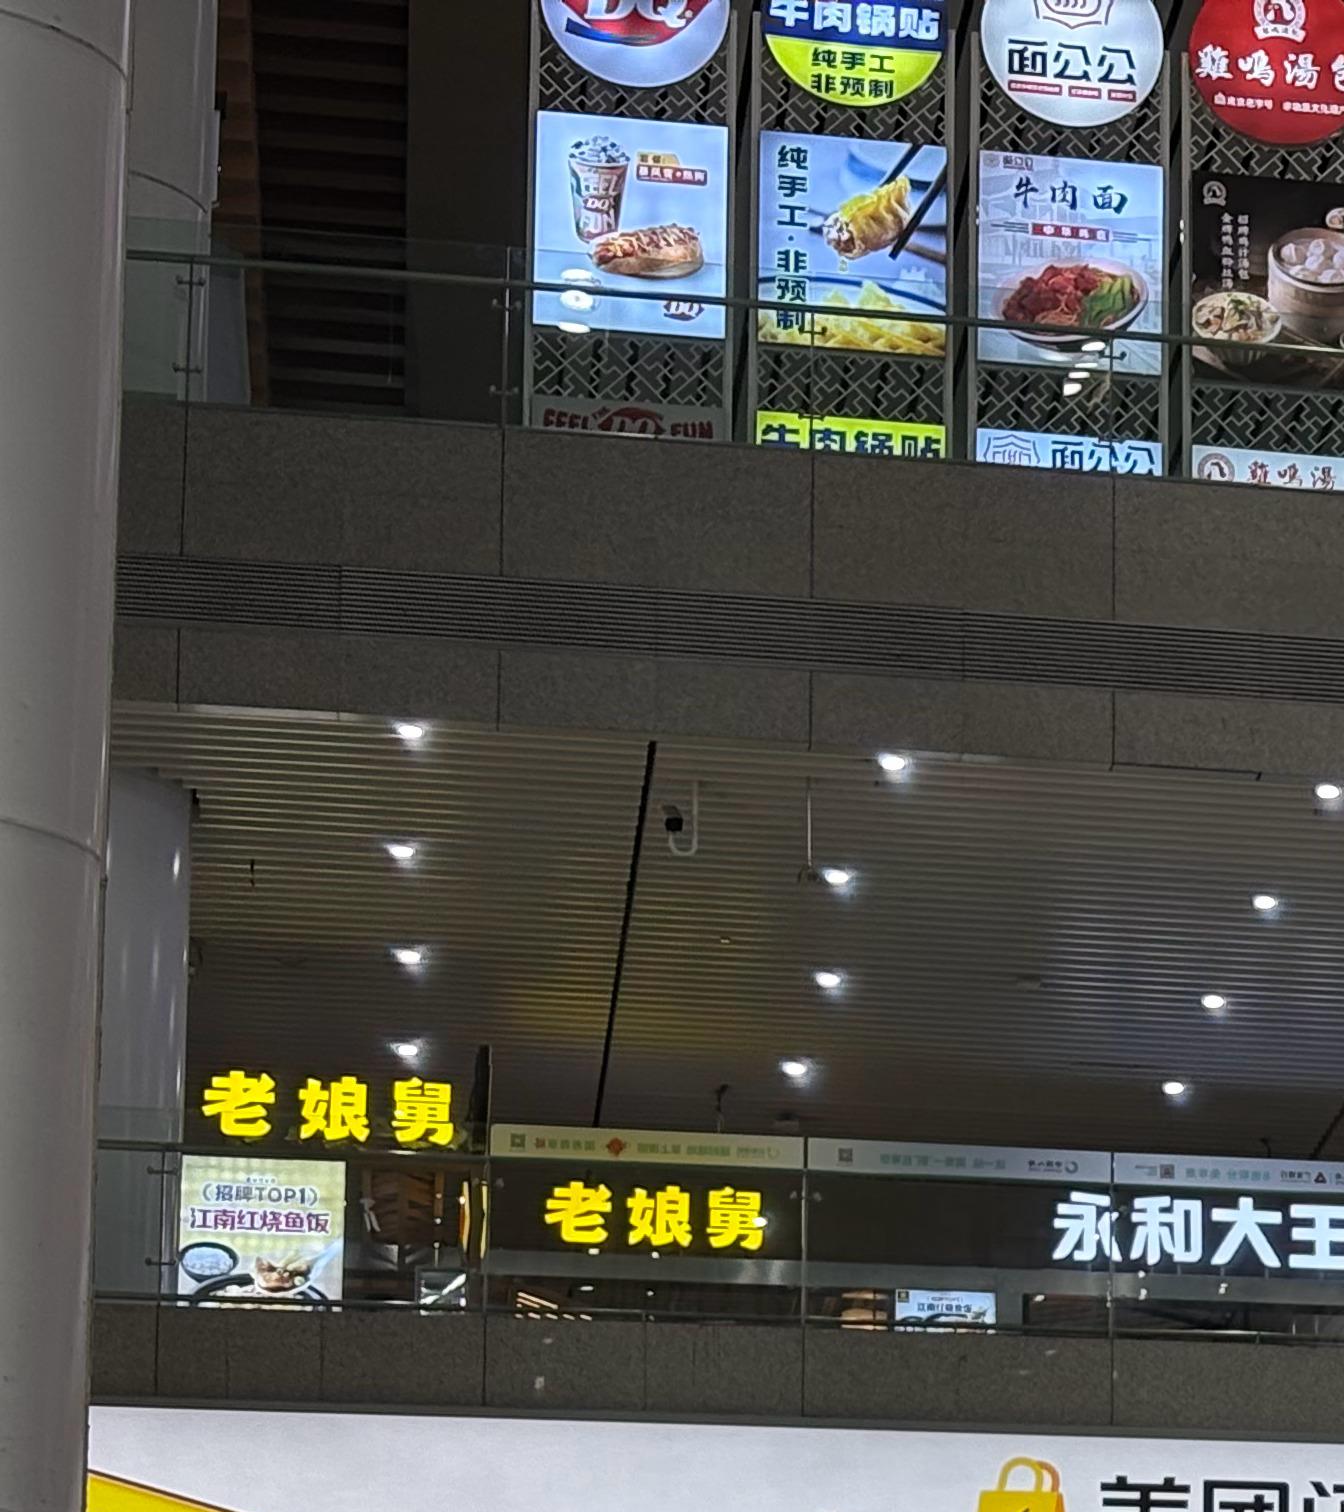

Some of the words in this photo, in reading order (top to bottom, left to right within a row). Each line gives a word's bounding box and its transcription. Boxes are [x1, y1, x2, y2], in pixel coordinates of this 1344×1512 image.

[769, 0, 941, 39] 牛肉锅贴
[811, 47, 895, 75] 纯手工
[1008, 38, 1137, 86] 面公公
[811, 73, 894, 98] 非预制
[1013, 176, 1129, 215] 牛肉面
[1051, 441, 1156, 475] 面公公
[203, 1070, 455, 1146] 老娘舅
[190, 1208, 329, 1234] 江南红烧鱼饭
[545, 1181, 768, 1251] 老娘舅
